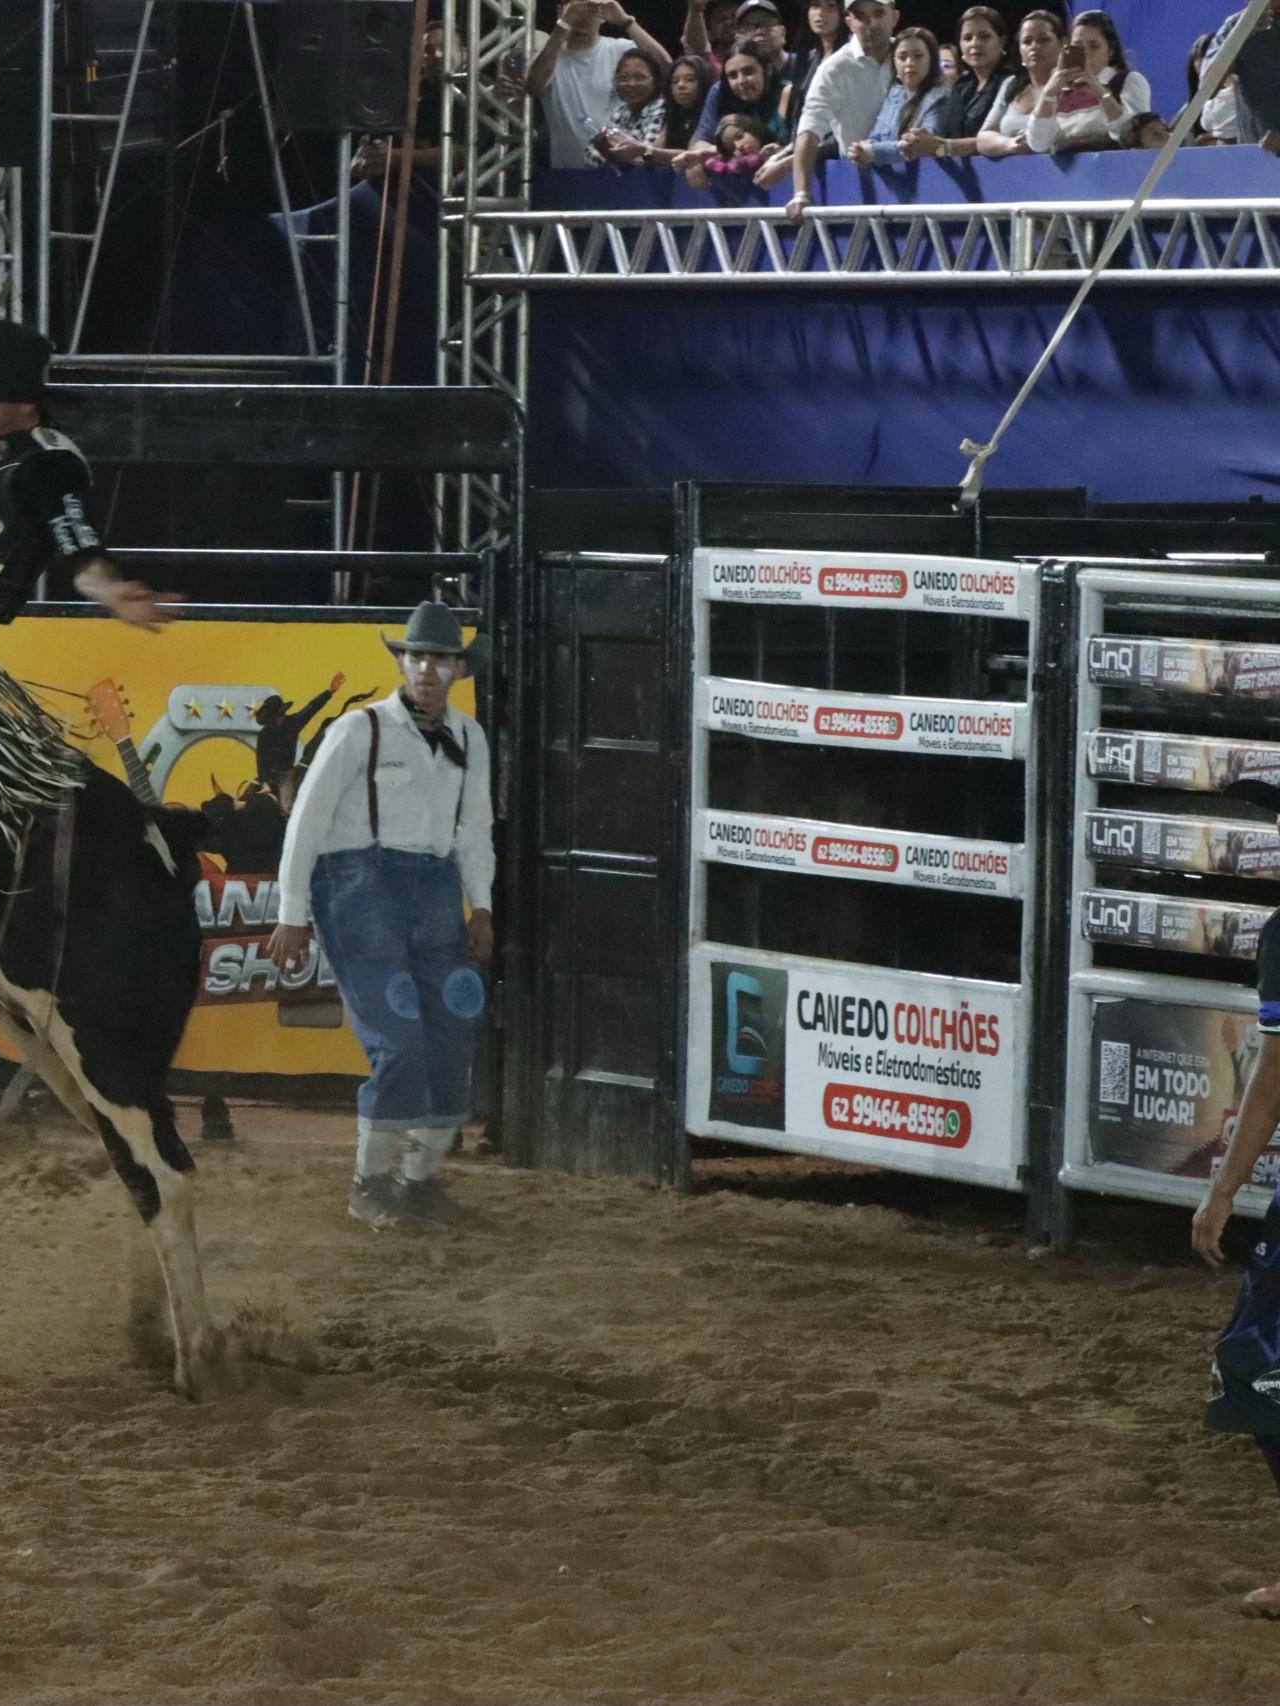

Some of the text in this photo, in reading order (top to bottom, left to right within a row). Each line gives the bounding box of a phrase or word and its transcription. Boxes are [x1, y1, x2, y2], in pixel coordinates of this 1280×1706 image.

[713, 561, 812, 585] CANEDO COLCHÕES
[914, 570, 1015, 595] CANEDO COLCHÕES
[1089, 641, 1133, 676] LinQ
[713, 696, 809, 723] CANEDO COLCHÕES
[910, 712, 1012, 737] CANEDO COLCHÕES
[709, 821, 807, 852] CANEDO COLCHÕES
[1092, 820, 1136, 854] LinQ
[906, 846, 1007, 875] CANEDO COLCHÕES
[1089, 899, 1131, 933] LinQ
[797, 990, 1000, 1056] CANEDO COLCHÕES
[818, 1041, 982, 1090] Móveis e Eletrodomésticos
[1177, 1053, 1193, 1067] QUE
[1135, 1064, 1211, 1098] EM TODO
[831, 1094, 945, 1138] 62 99464-8556
[1134, 1094, 1195, 1126] LUGAR!
